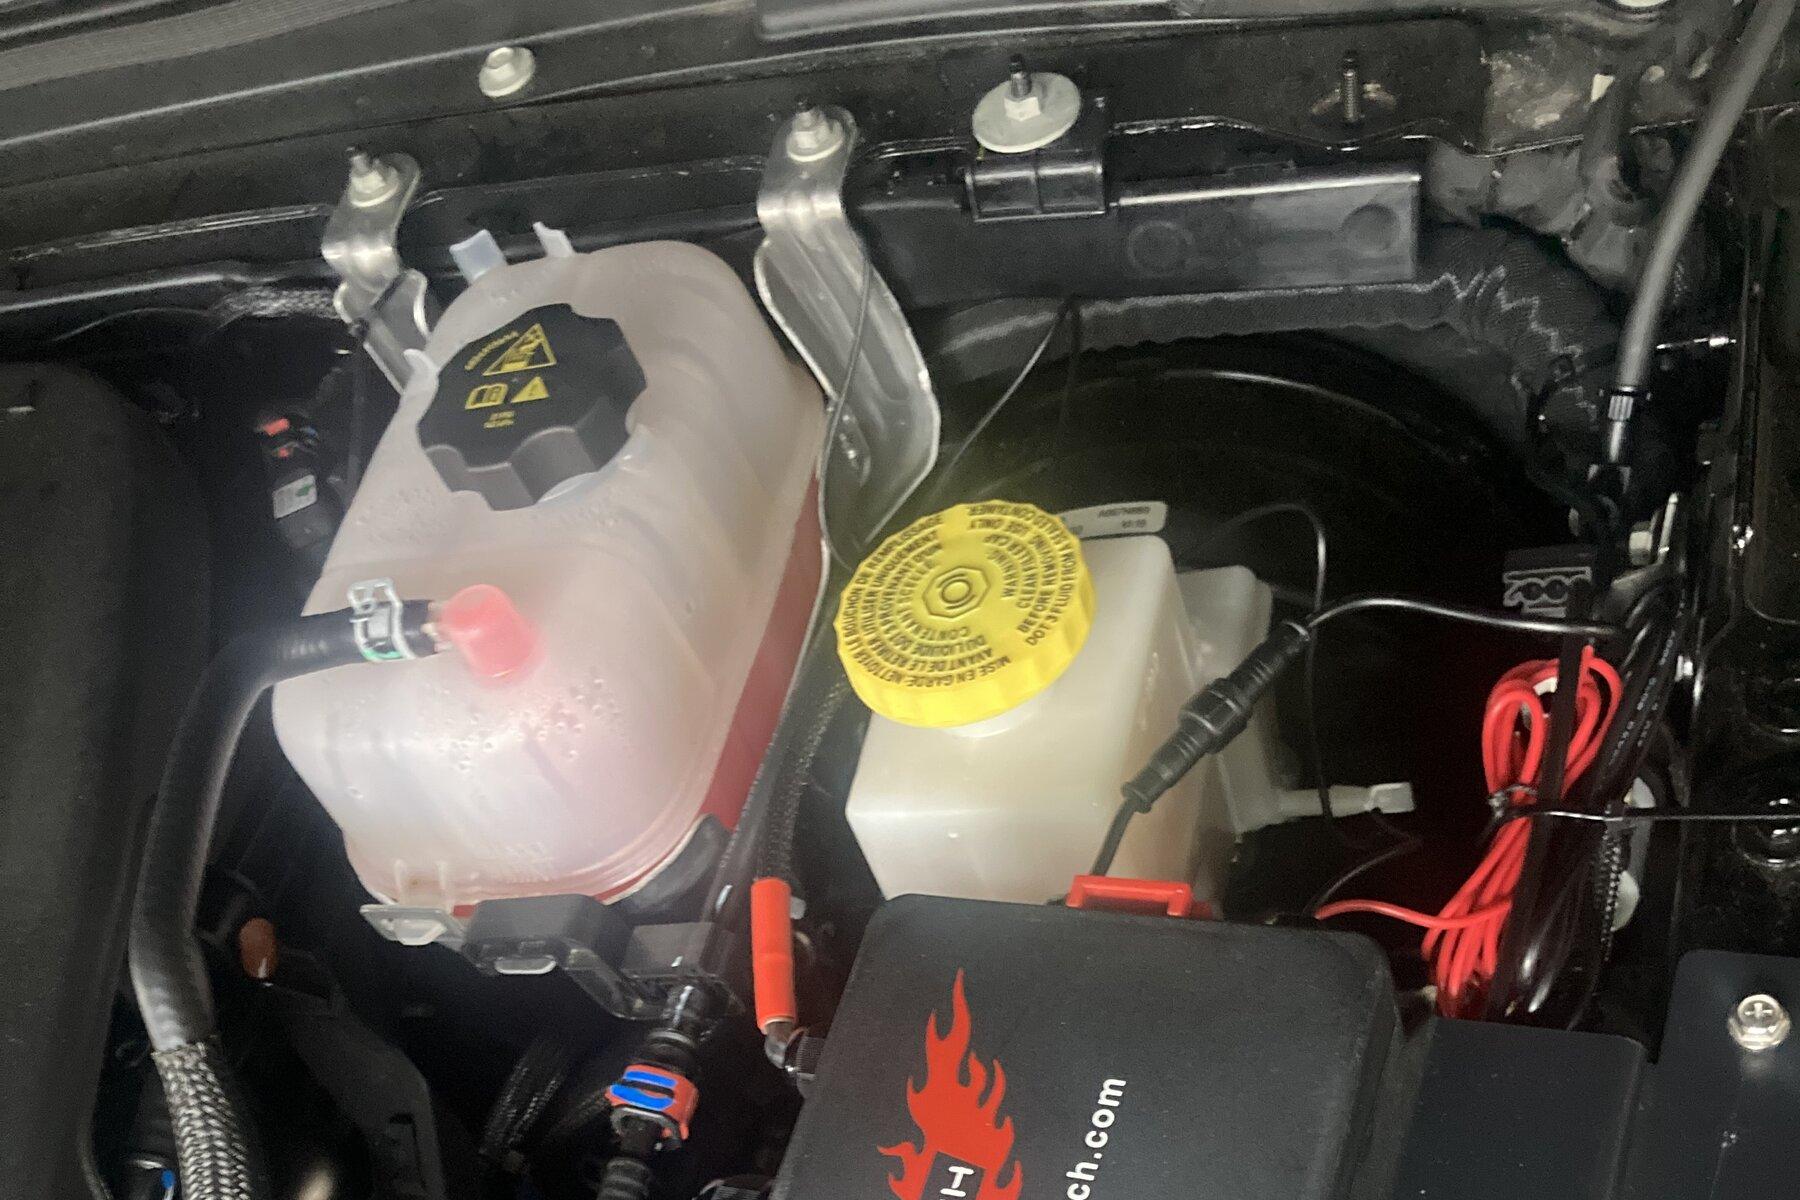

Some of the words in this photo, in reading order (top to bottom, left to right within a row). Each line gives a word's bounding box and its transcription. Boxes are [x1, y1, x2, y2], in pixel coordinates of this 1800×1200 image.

[864, 513, 944, 570] REMPLISSAGE
[981, 532, 1013, 548] CAP
[1003, 539, 1039, 573] FILLER
[868, 528, 940, 588] UNIQUEMENT
[1059, 549, 1077, 582] FROM
[853, 571, 872, 585] DE
[1014, 570, 1038, 609] CLEAN
[843, 587, 864, 638] BOUCHON
[860, 590, 880, 637] UTILISER
[1015, 590, 1055, 634] BEFORE
[1049, 581, 1076, 614] FLUID
[845, 635, 863, 652] LE
[1024, 623, 1053, 647] DOT
[948, 647, 995, 671] AVANT
[978, 654, 1012, 677] MISE
[955, 668, 976, 684] EN
